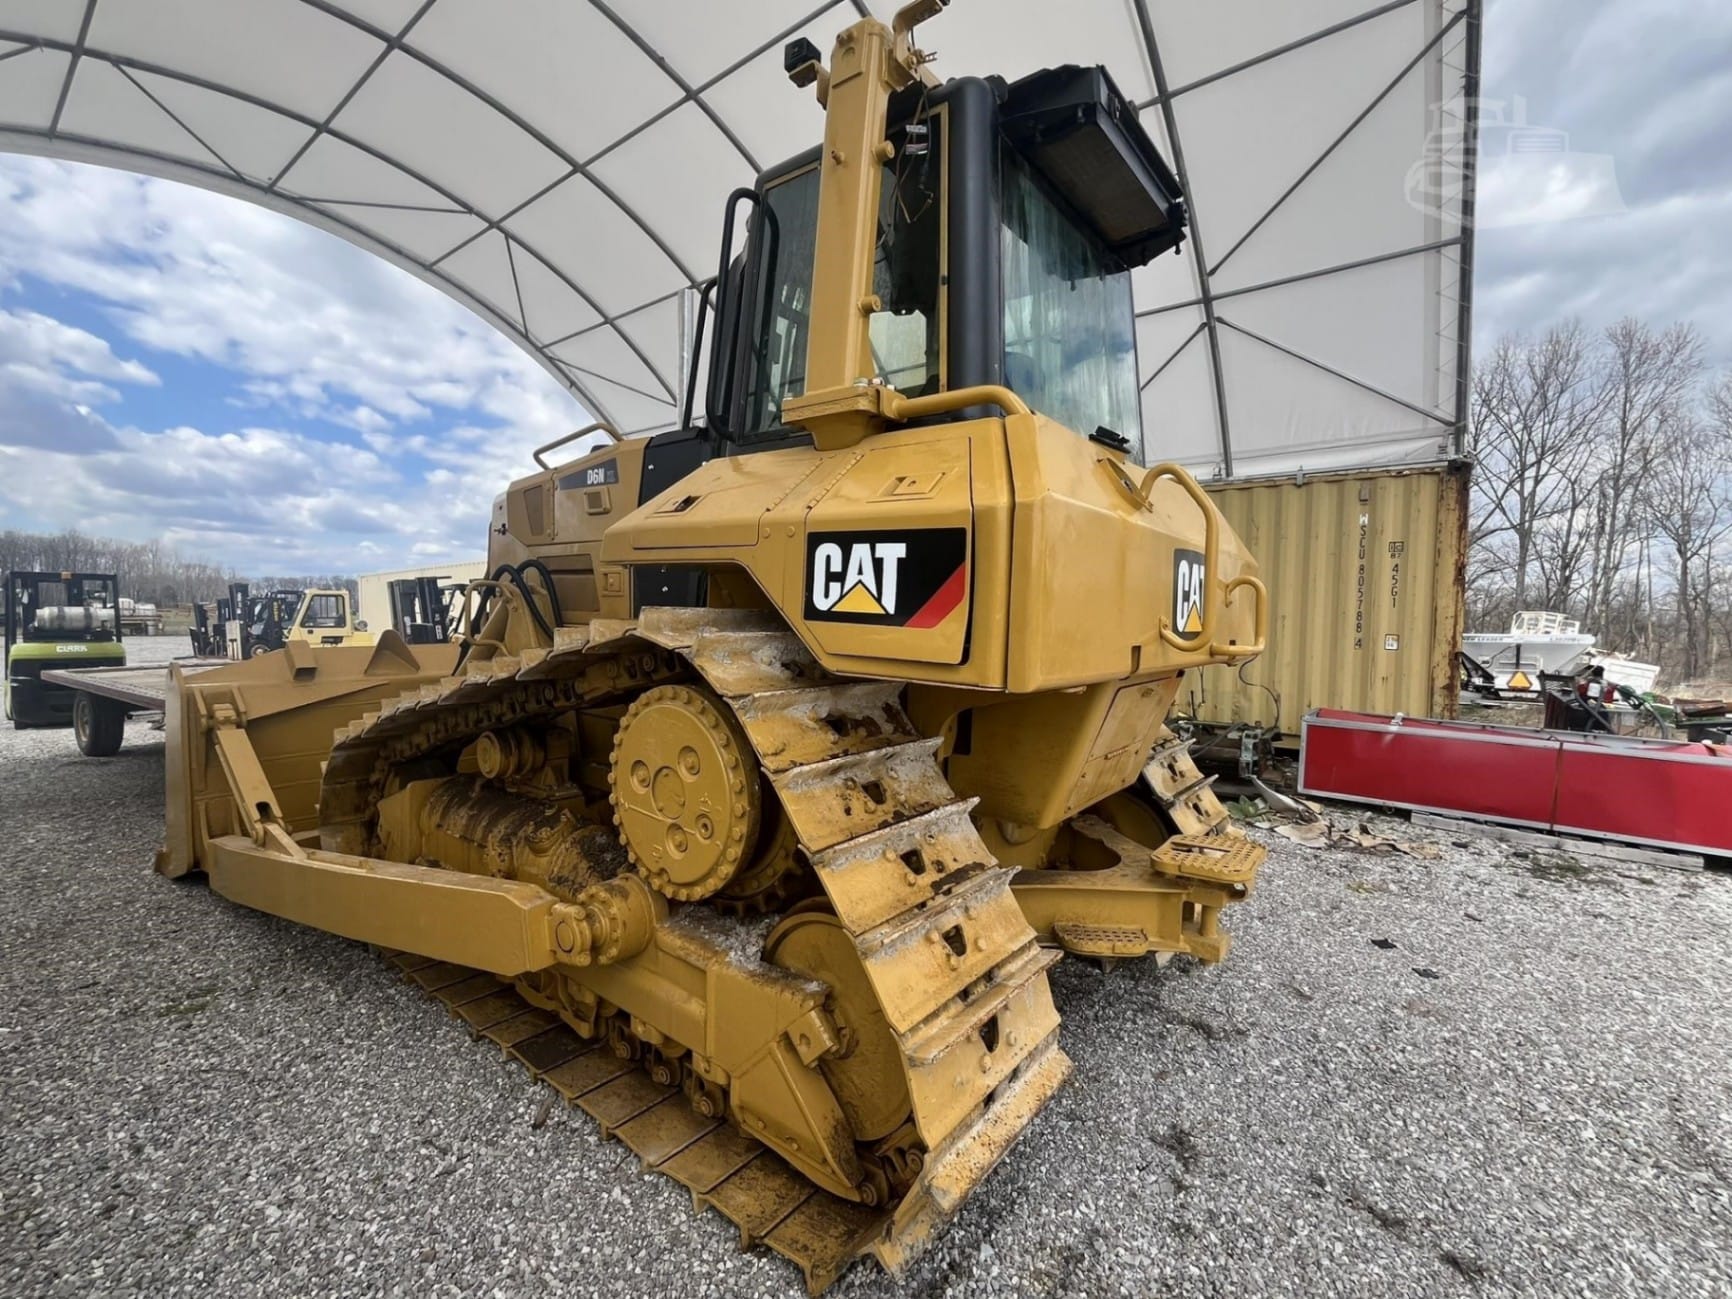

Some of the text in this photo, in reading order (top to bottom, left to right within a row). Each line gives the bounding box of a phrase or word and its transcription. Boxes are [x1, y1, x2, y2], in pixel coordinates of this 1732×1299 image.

[586, 468, 605, 485] D6N
[812, 542, 907, 615] CAT
[1354, 513, 1369, 649] WSCU 805788 4
[1390, 563, 1400, 608] 45G1
[56, 645, 88, 653] CLARK
